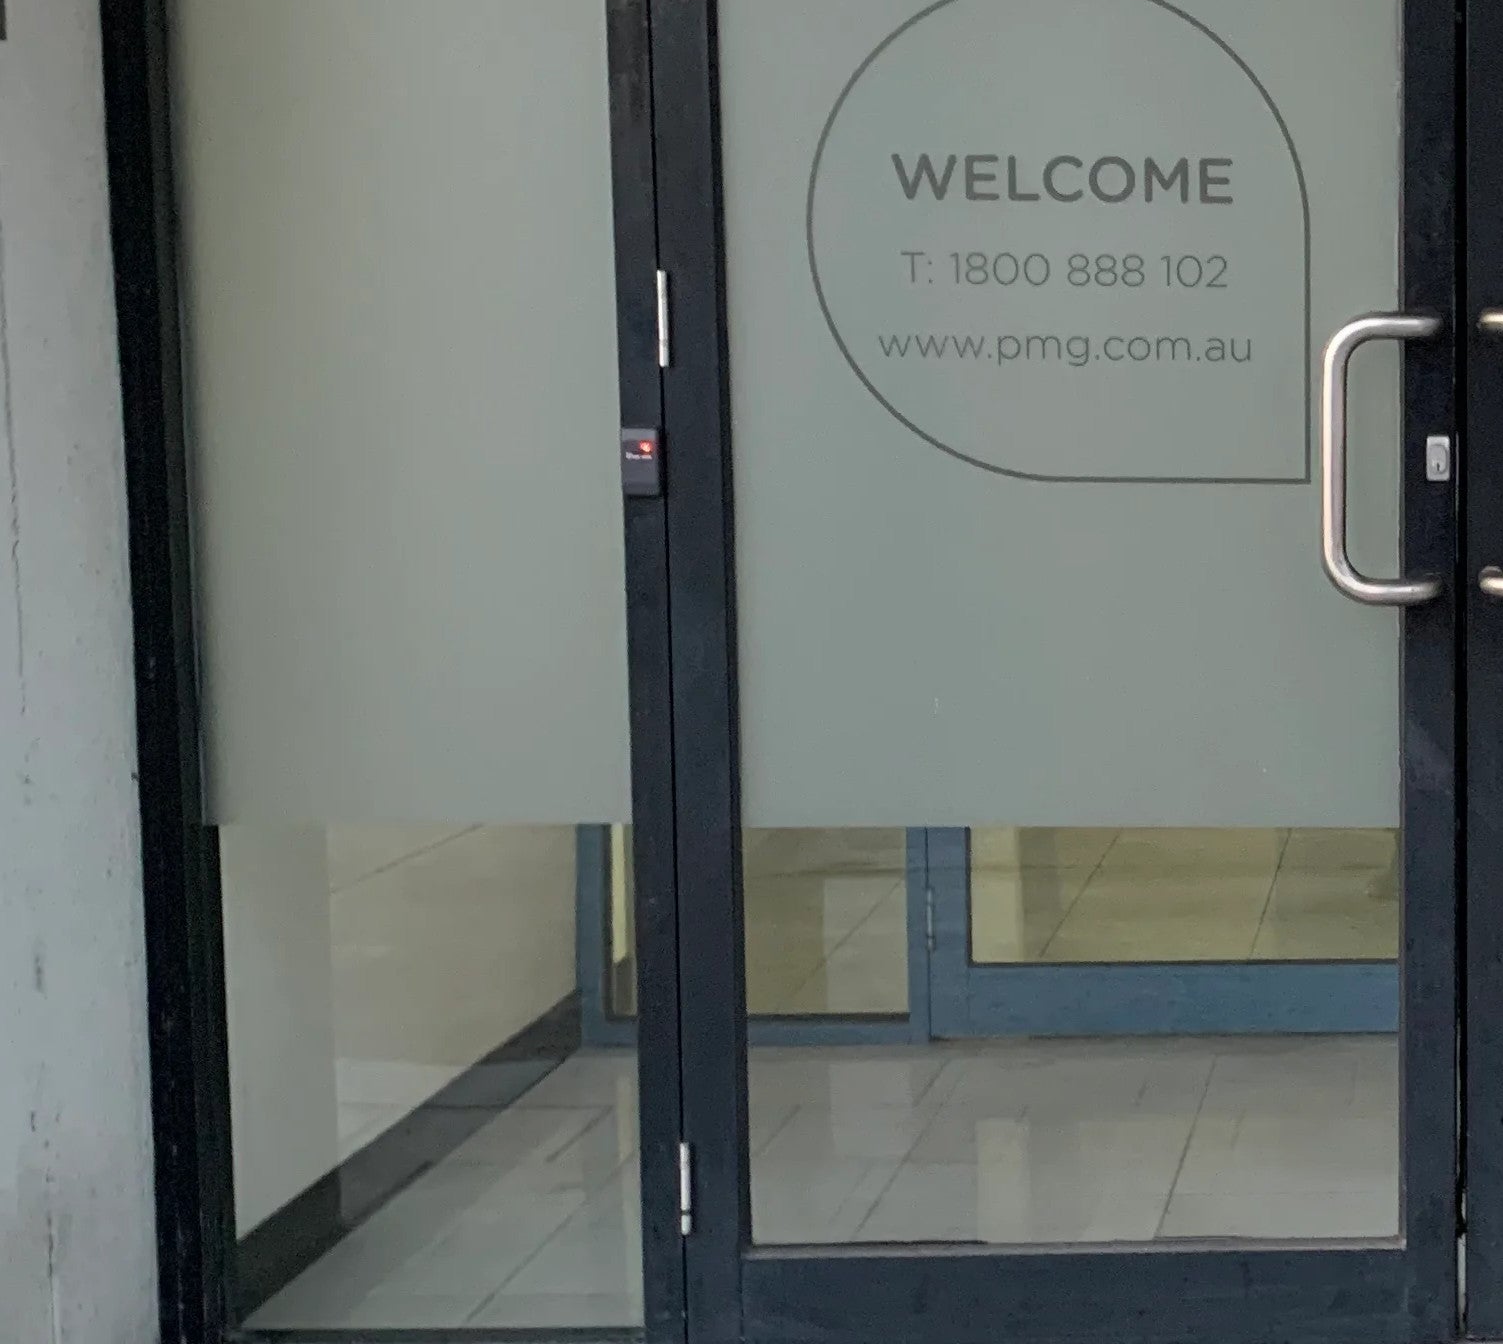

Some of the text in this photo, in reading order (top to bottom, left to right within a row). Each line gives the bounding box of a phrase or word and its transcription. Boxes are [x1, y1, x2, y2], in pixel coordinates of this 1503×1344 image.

[891, 152, 1234, 204] WELCOME
[901, 251, 1229, 289] T: 1800 888 102
[878, 333, 1252, 366] www.pmg.com.au
